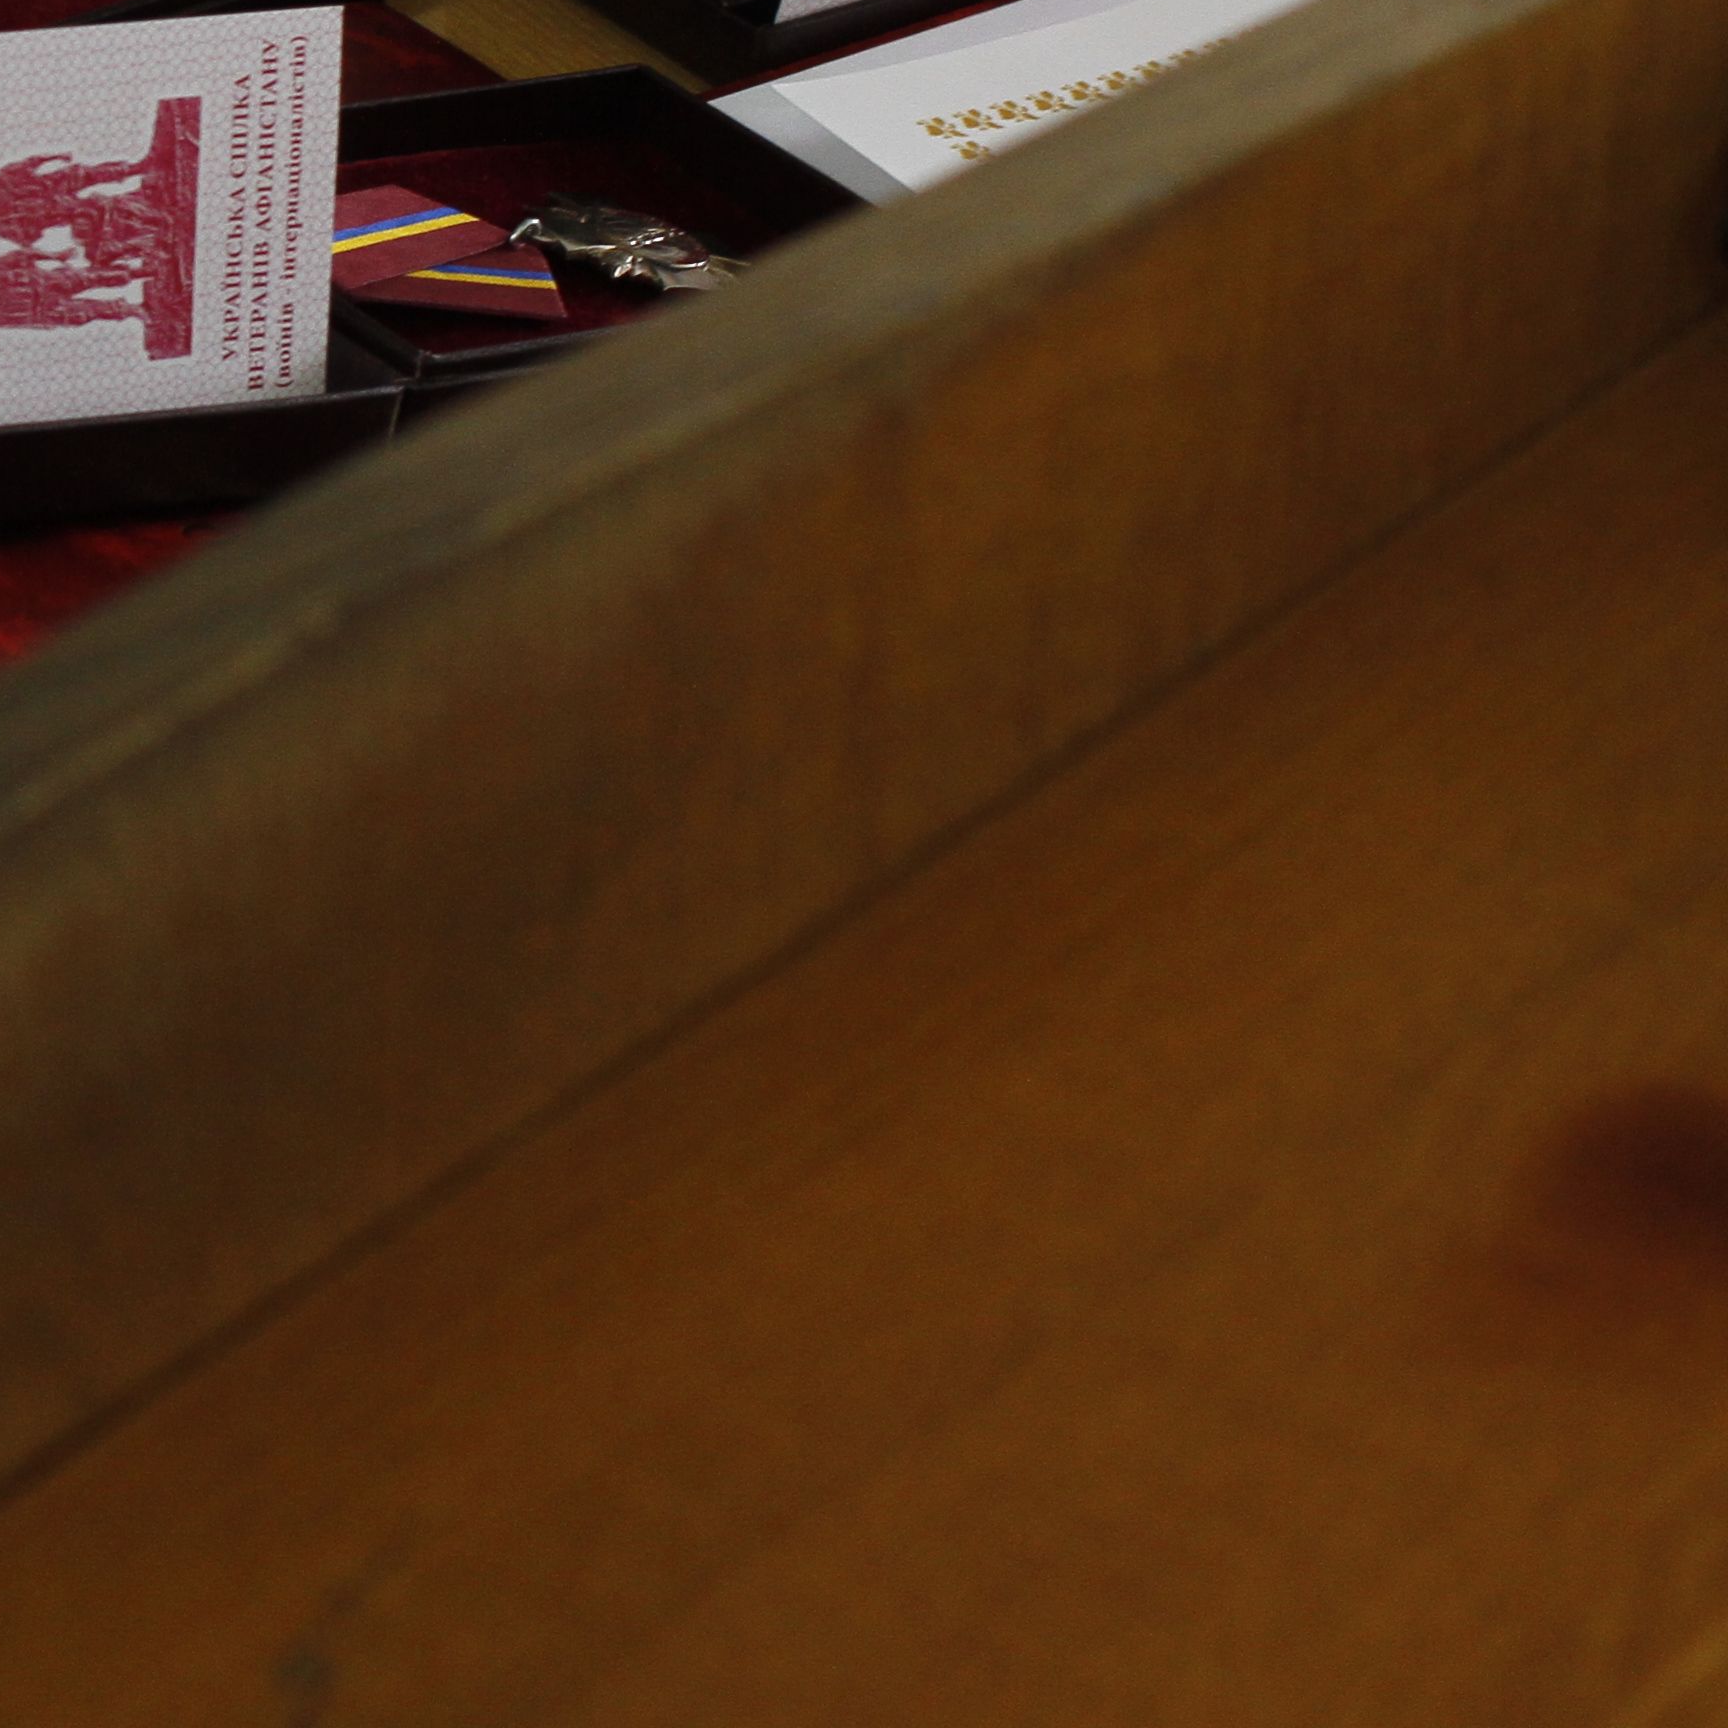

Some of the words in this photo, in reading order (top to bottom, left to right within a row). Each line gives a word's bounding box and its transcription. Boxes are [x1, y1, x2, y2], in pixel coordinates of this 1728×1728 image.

[229, 74, 251, 180] СПІЛКА
[253, 39, 280, 232] АФГАНІСТАНУ
[278, 35, 309, 280] інтернаціоналістів)
[220, 186, 247, 362] УКРАЇНСЬКА
[245, 241, 271, 392] ВЕТЕРАНІВ
[273, 302, 295, 390] (воїнів
